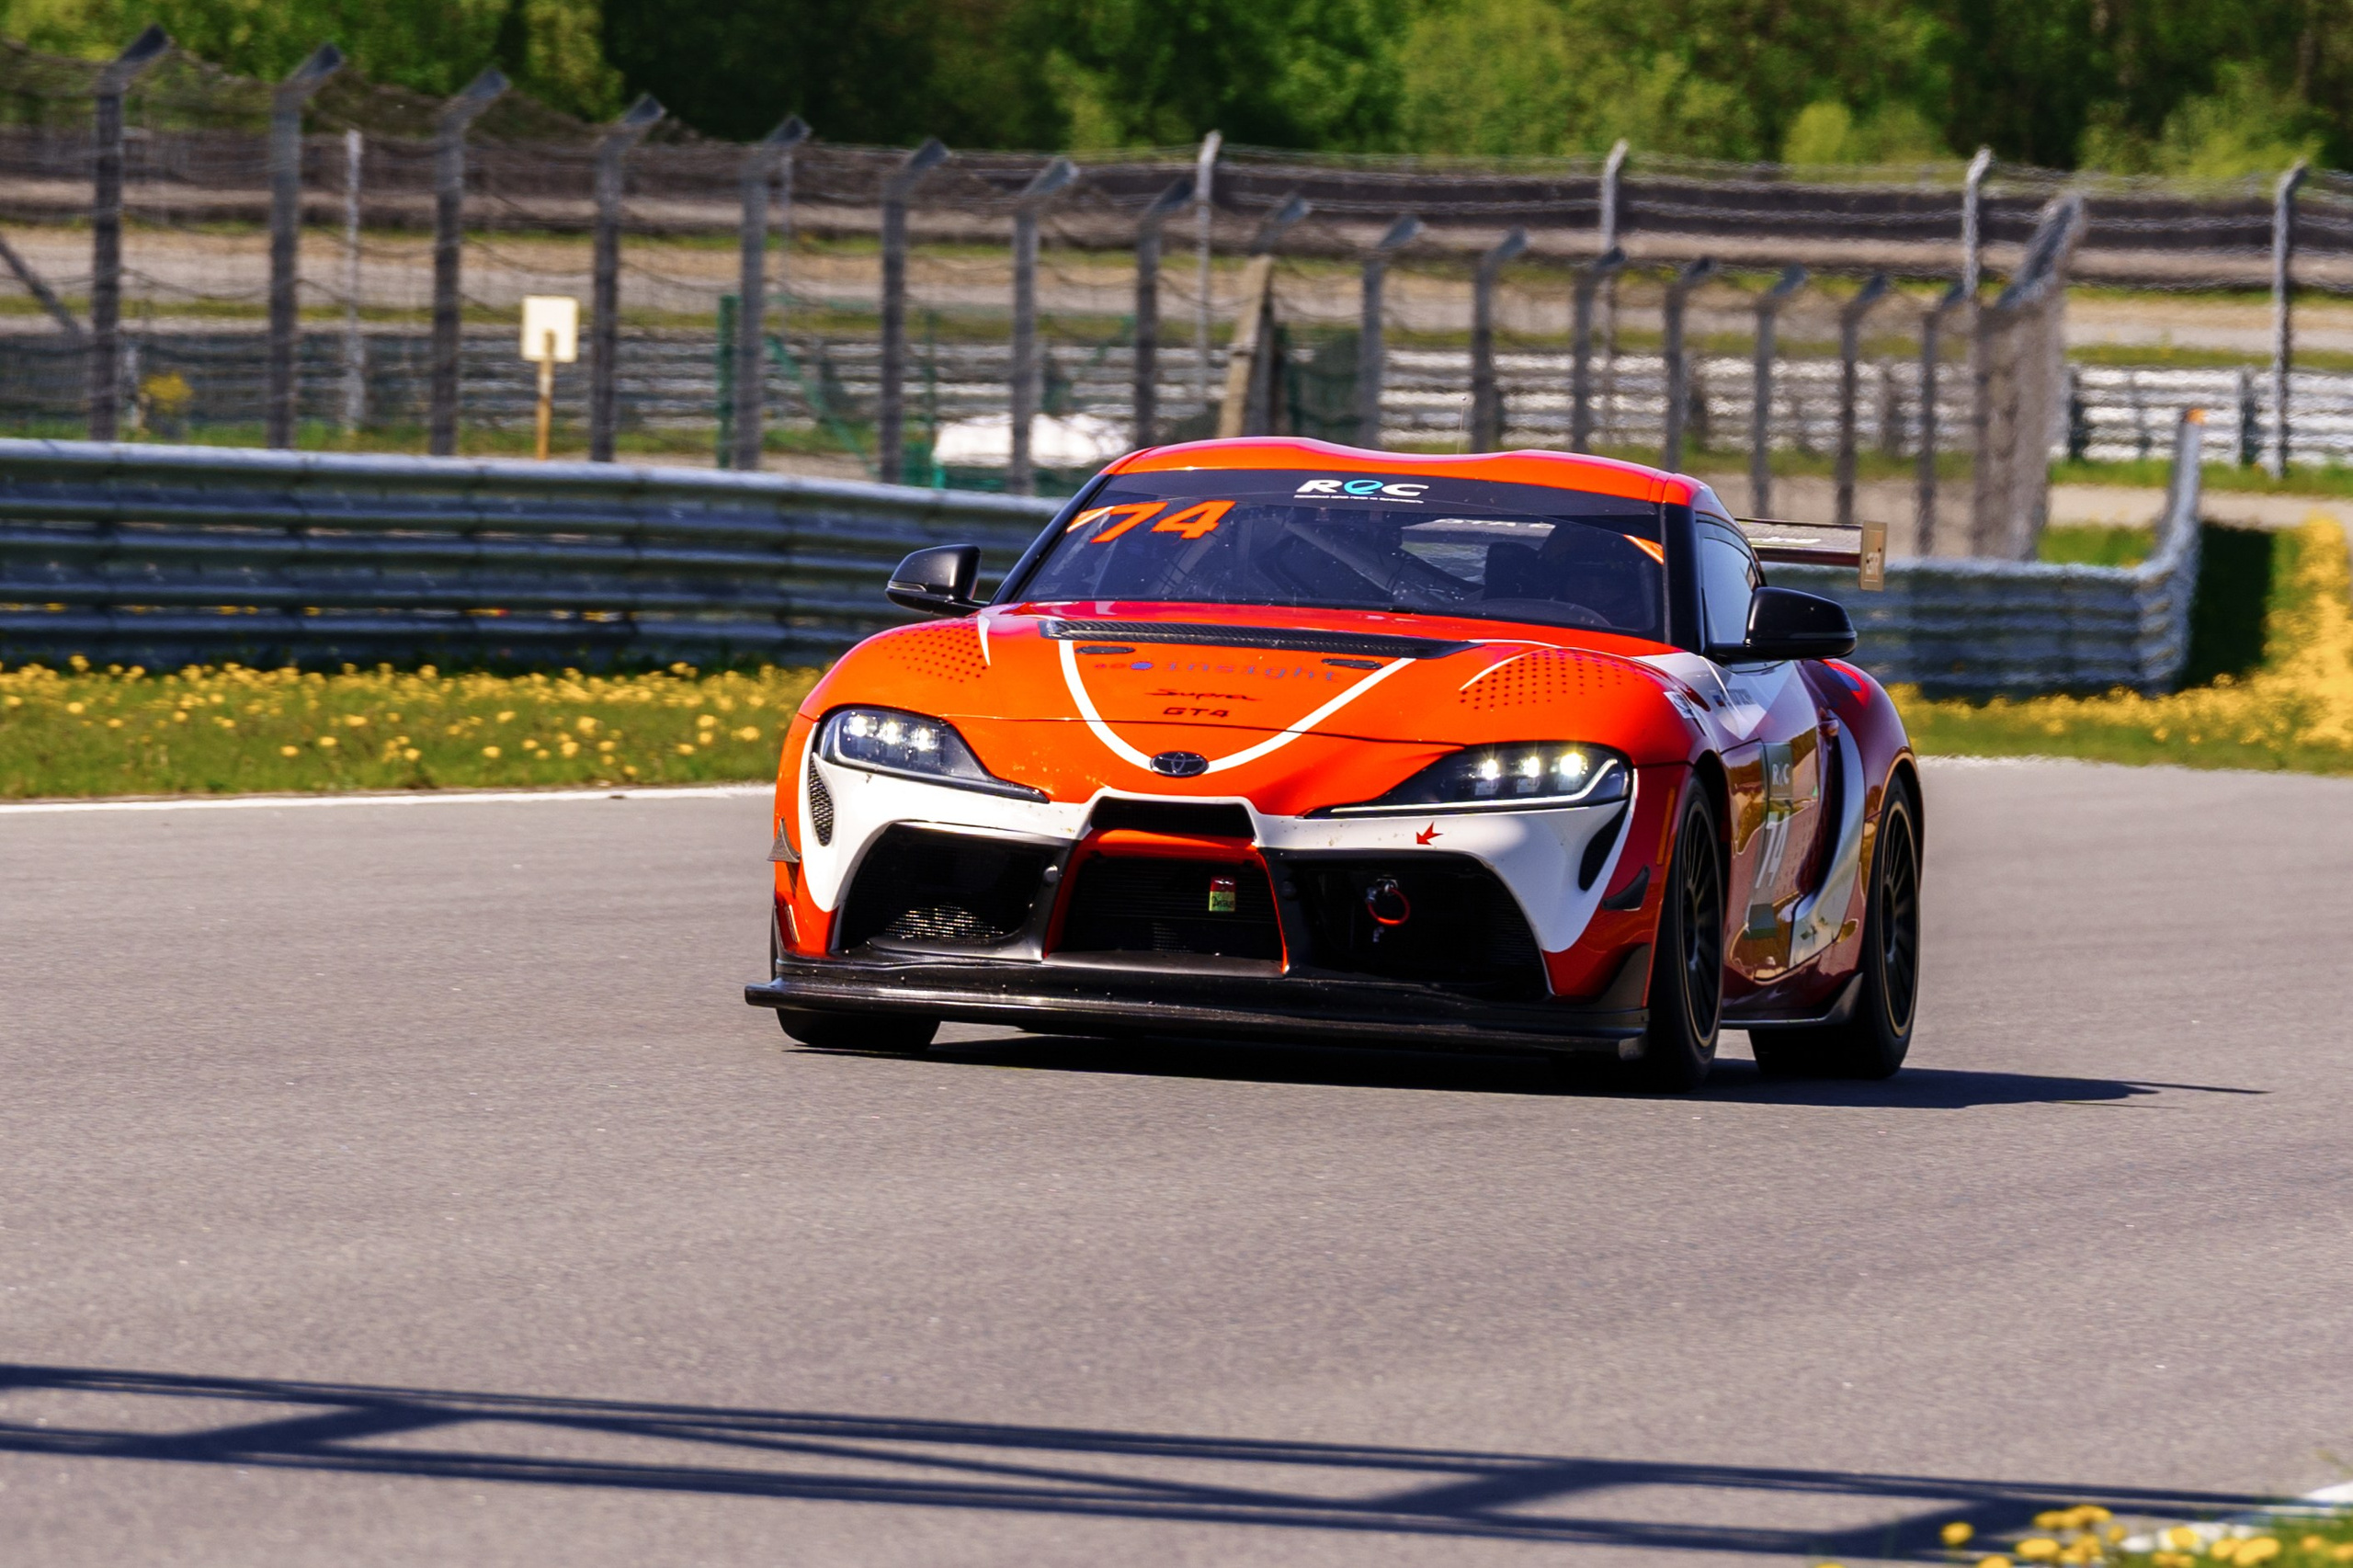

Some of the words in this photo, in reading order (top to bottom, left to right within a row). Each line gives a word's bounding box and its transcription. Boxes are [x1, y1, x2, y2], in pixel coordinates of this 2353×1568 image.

[1066, 500, 1236, 543] 74
[1164, 661, 1340, 682] insight
[1146, 688, 1262, 701] Supra
[1163, 706, 1230, 718] GT4
[1755, 811, 1790, 889] 74
